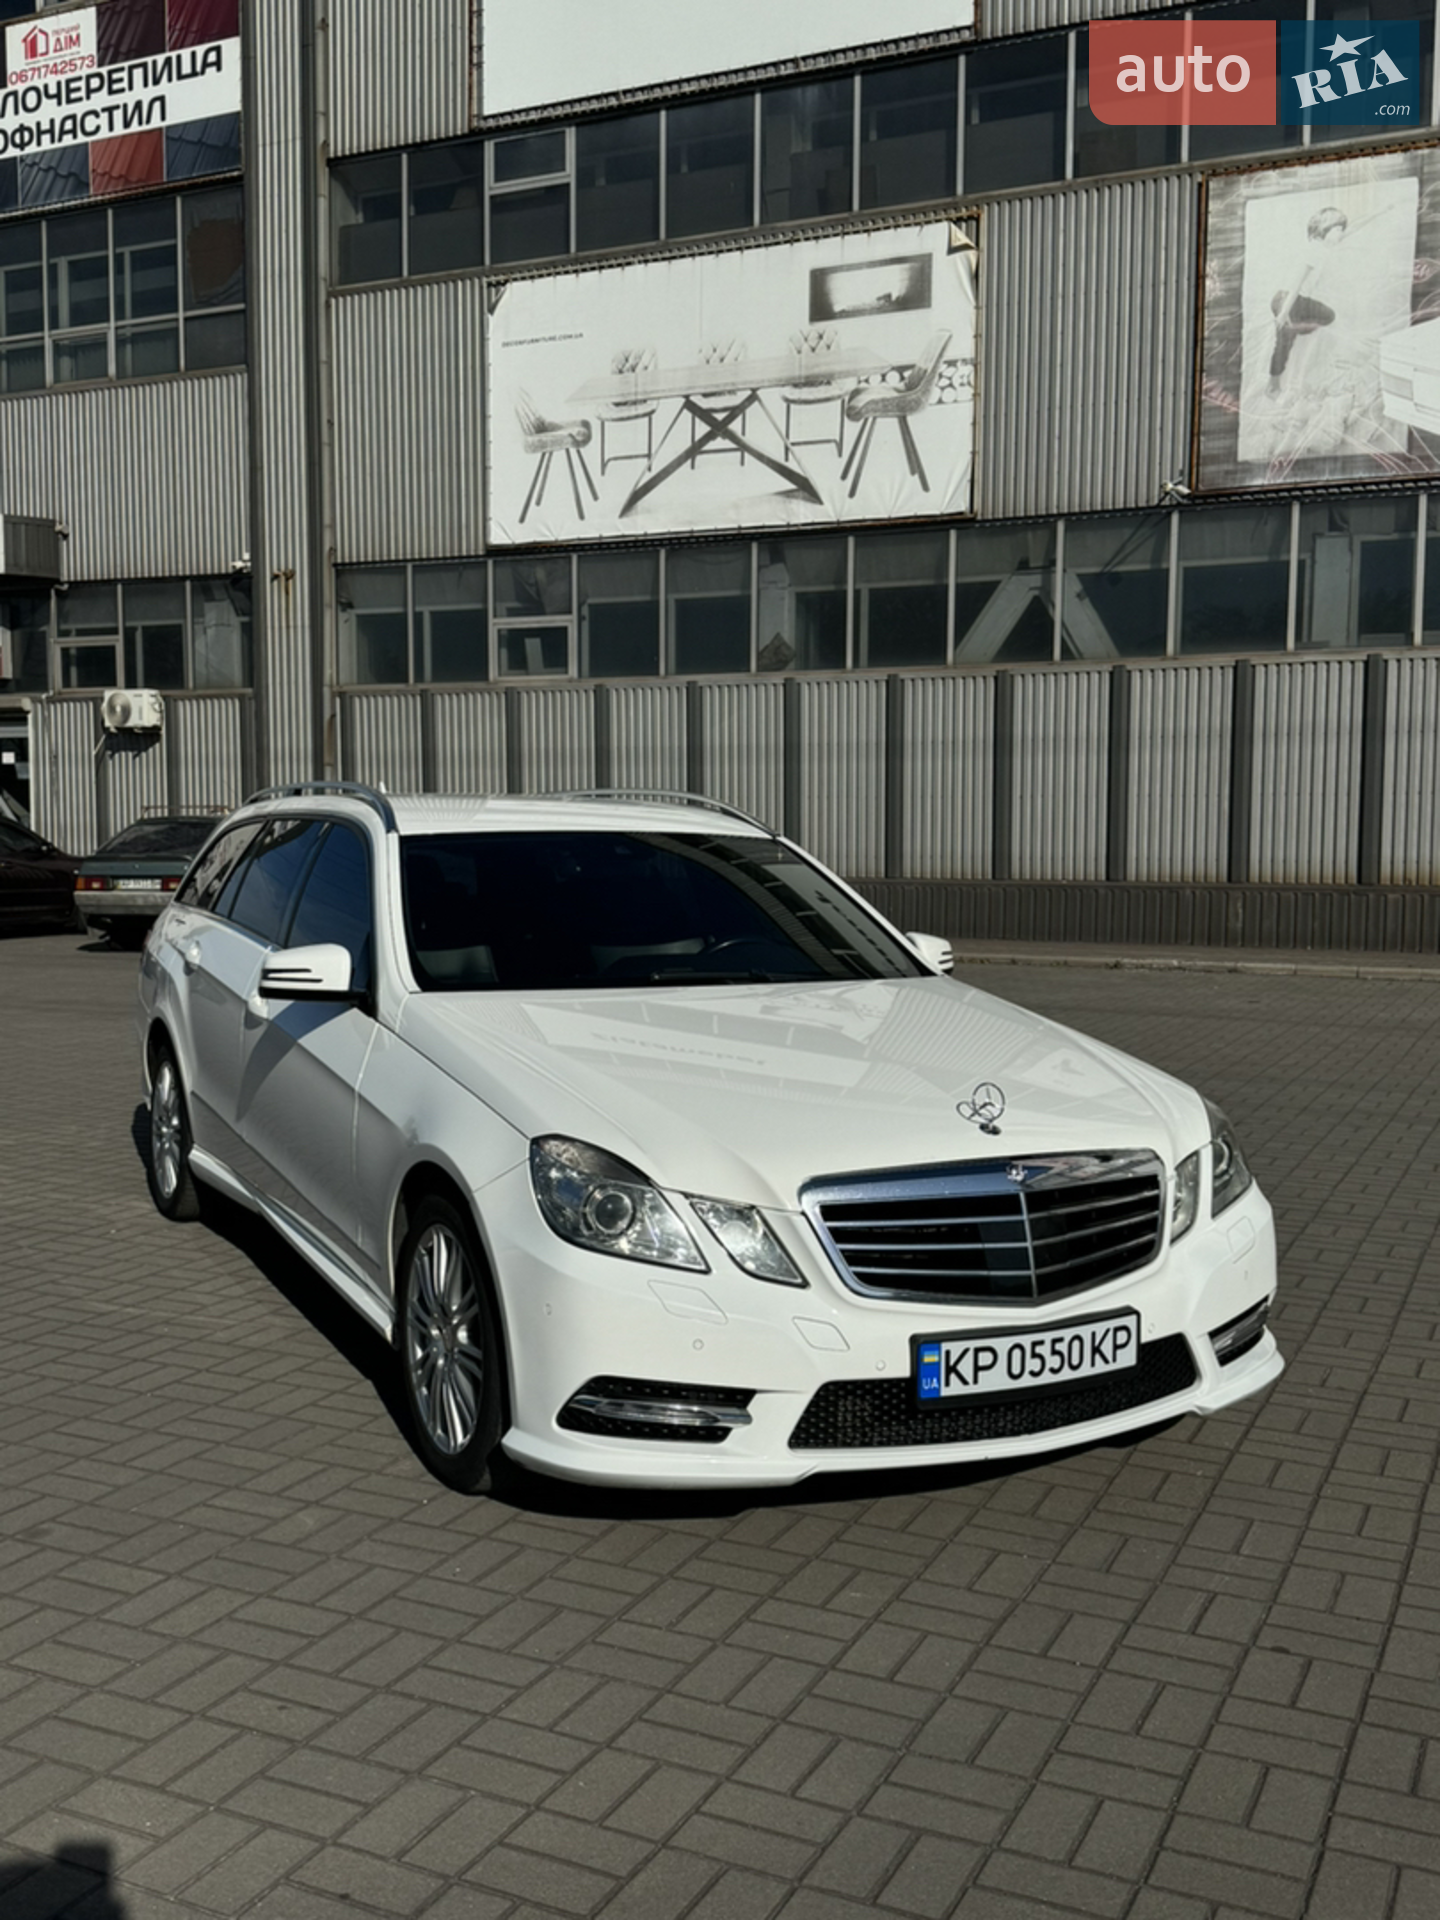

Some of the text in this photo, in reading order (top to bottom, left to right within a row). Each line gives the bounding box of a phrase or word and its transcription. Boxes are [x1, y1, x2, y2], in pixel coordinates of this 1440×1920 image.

[0, 45, 222, 119] ЛОЧЕРЕПИЦА
[8, 54, 96, 86] 0671742573
[922, 1325, 1132, 1390] UA KP 0550 KP
